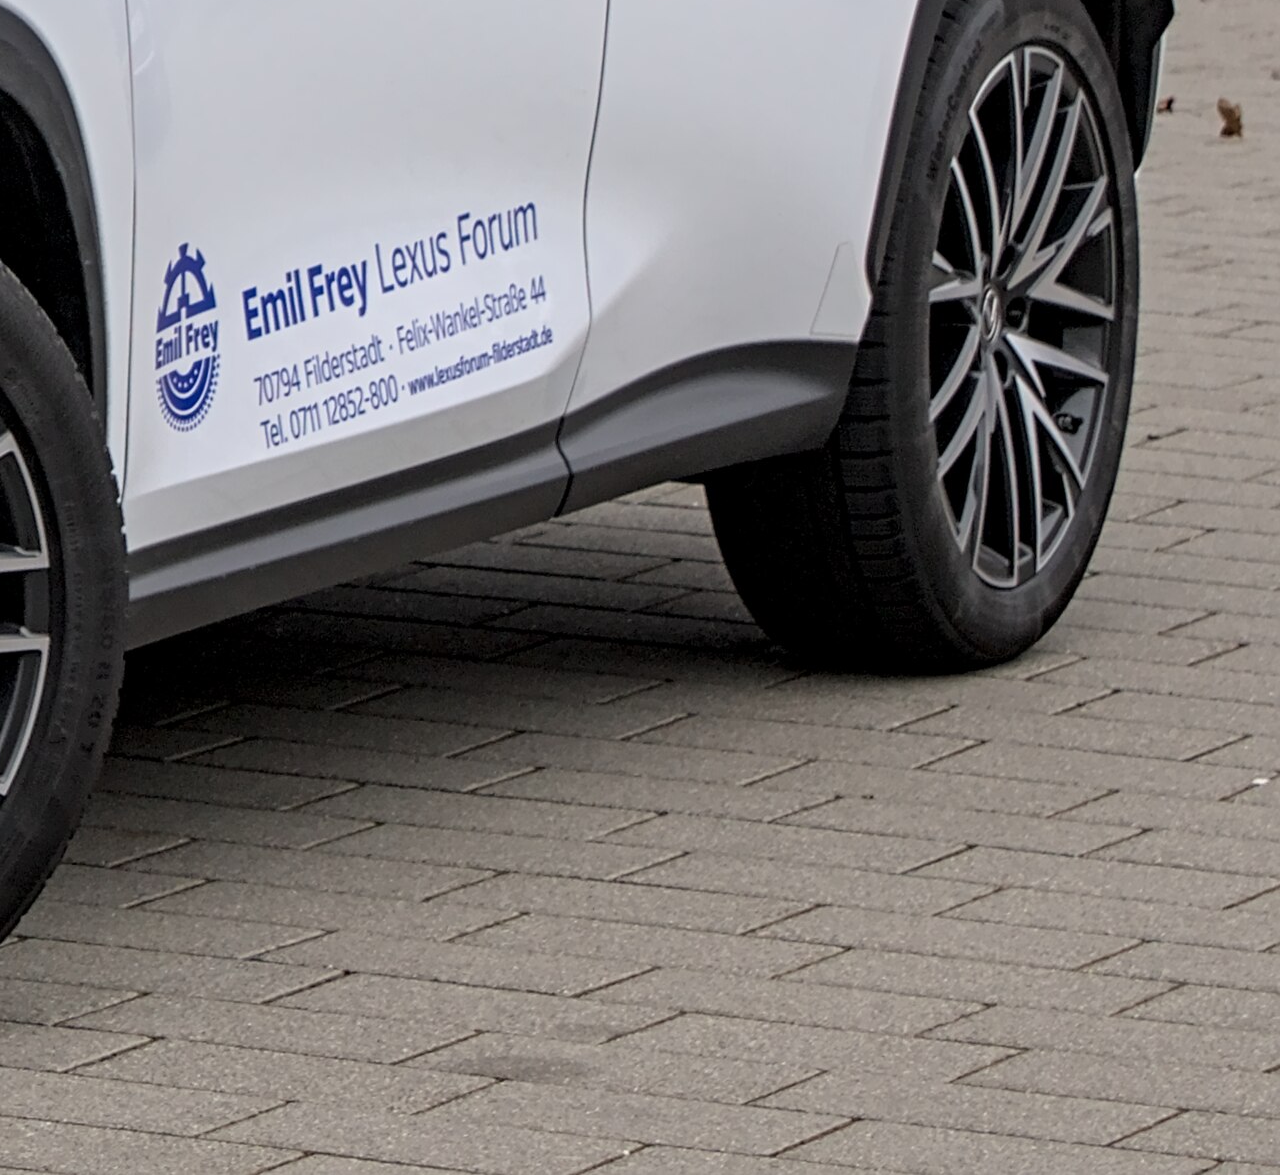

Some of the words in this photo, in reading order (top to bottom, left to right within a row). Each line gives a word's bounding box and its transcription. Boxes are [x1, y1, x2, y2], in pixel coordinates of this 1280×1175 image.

[242, 268, 307, 341] Emil
[307, 259, 368, 318] Frey
[375, 230, 451, 294] Lexus
[457, 201, 539, 266] Forum
[154, 324, 183, 371] Emil
[185, 319, 219, 356] Frey
[253, 363, 302, 407] 70794
[304, 334, 386, 389] Filderstadt
[396, 282, 528, 356] Felix-Wankel-Straße
[530, 274, 547, 305] 44
[260, 413, 289, 450] Tel.
[289, 401, 322, 440] 0711
[322, 373, 399, 427] 12852-800
[407, 324, 554, 396] www.lexusforum-filderstadt.de
